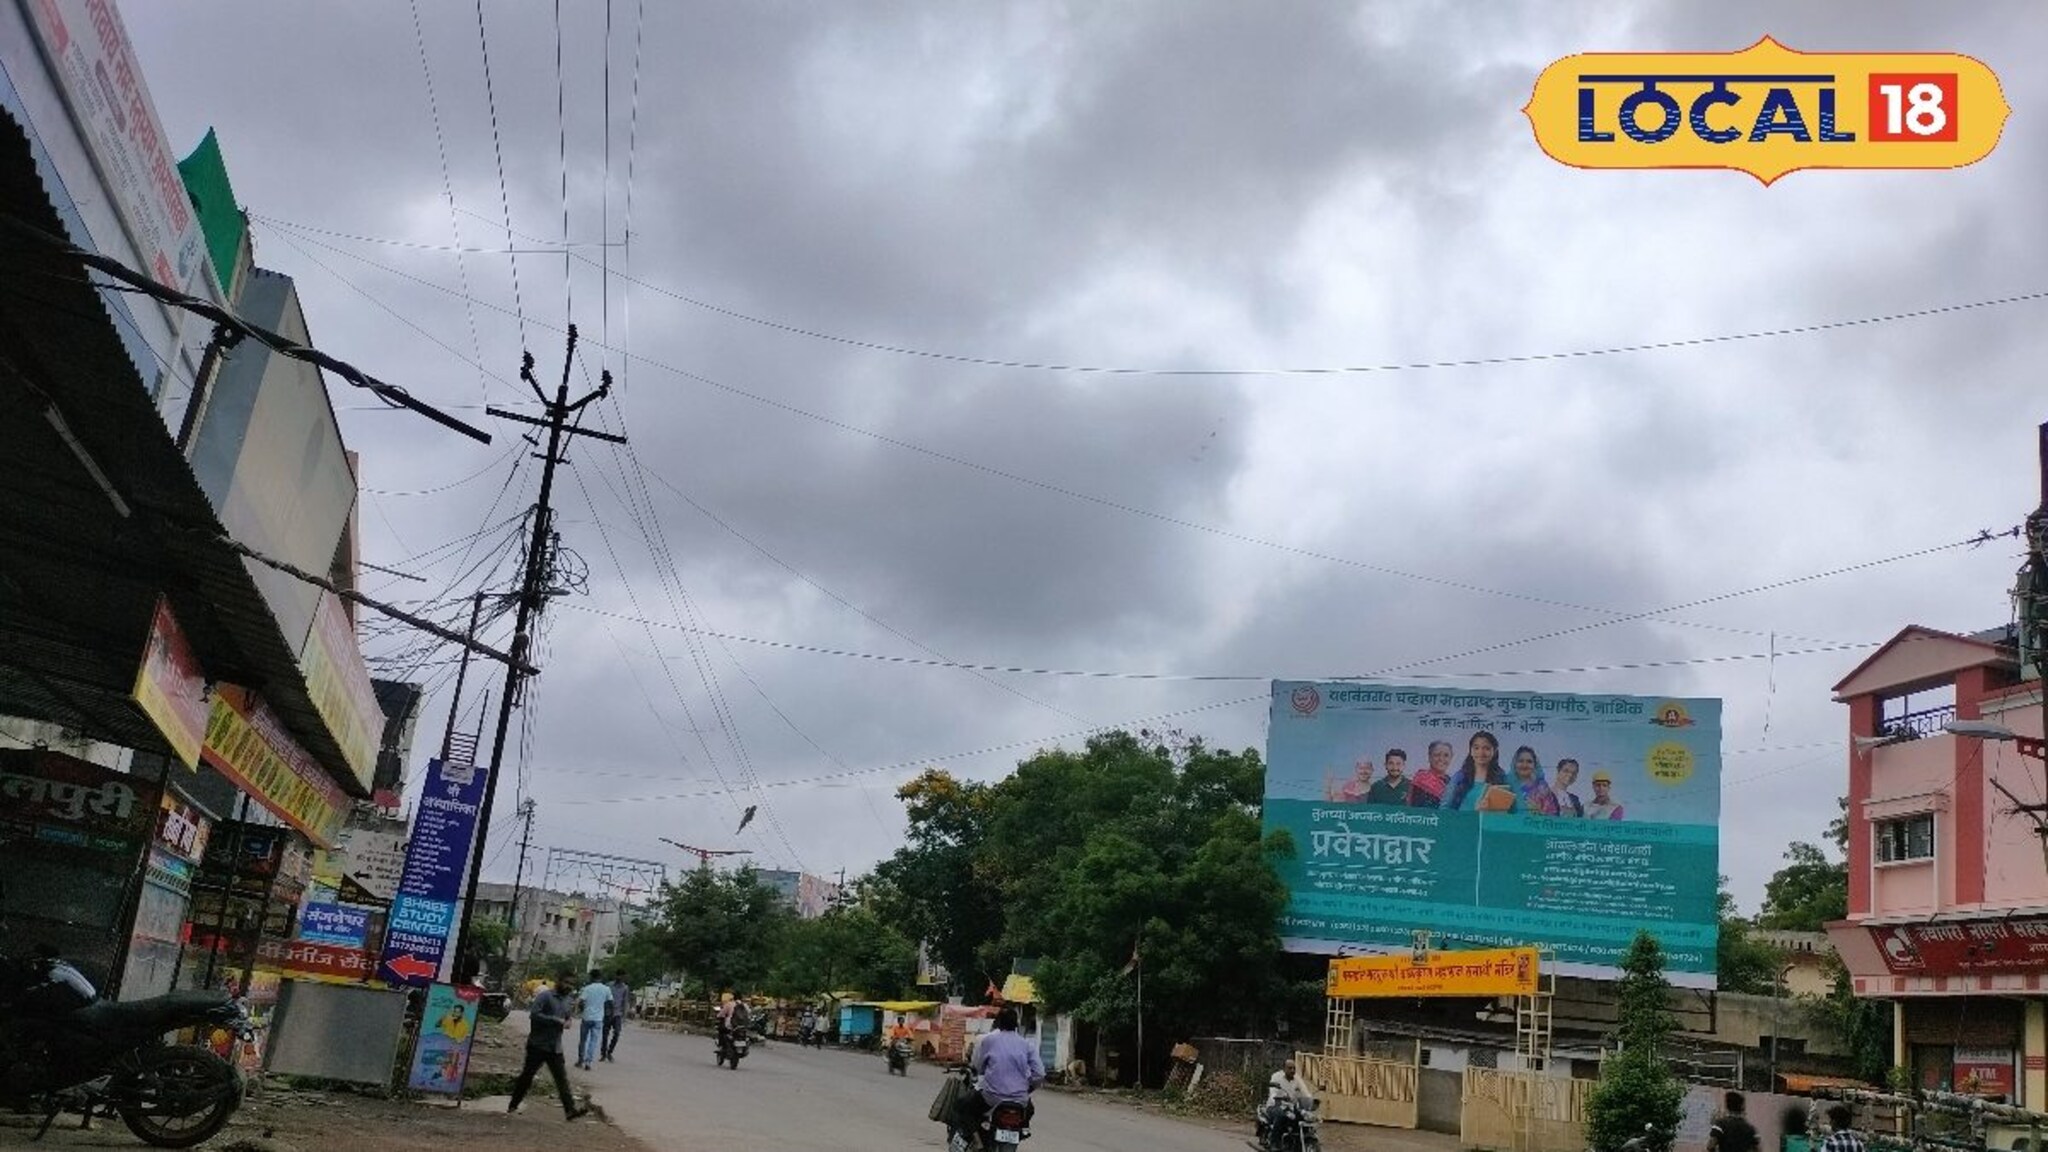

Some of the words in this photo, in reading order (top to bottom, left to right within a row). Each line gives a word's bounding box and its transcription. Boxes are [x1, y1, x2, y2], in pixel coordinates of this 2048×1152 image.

[1310, 822, 1437, 865] प्रवेशद्वार
[402, 896, 449, 913] SHREE
[399, 907, 446, 924] STUDY
[391, 917, 449, 936] CENTER
